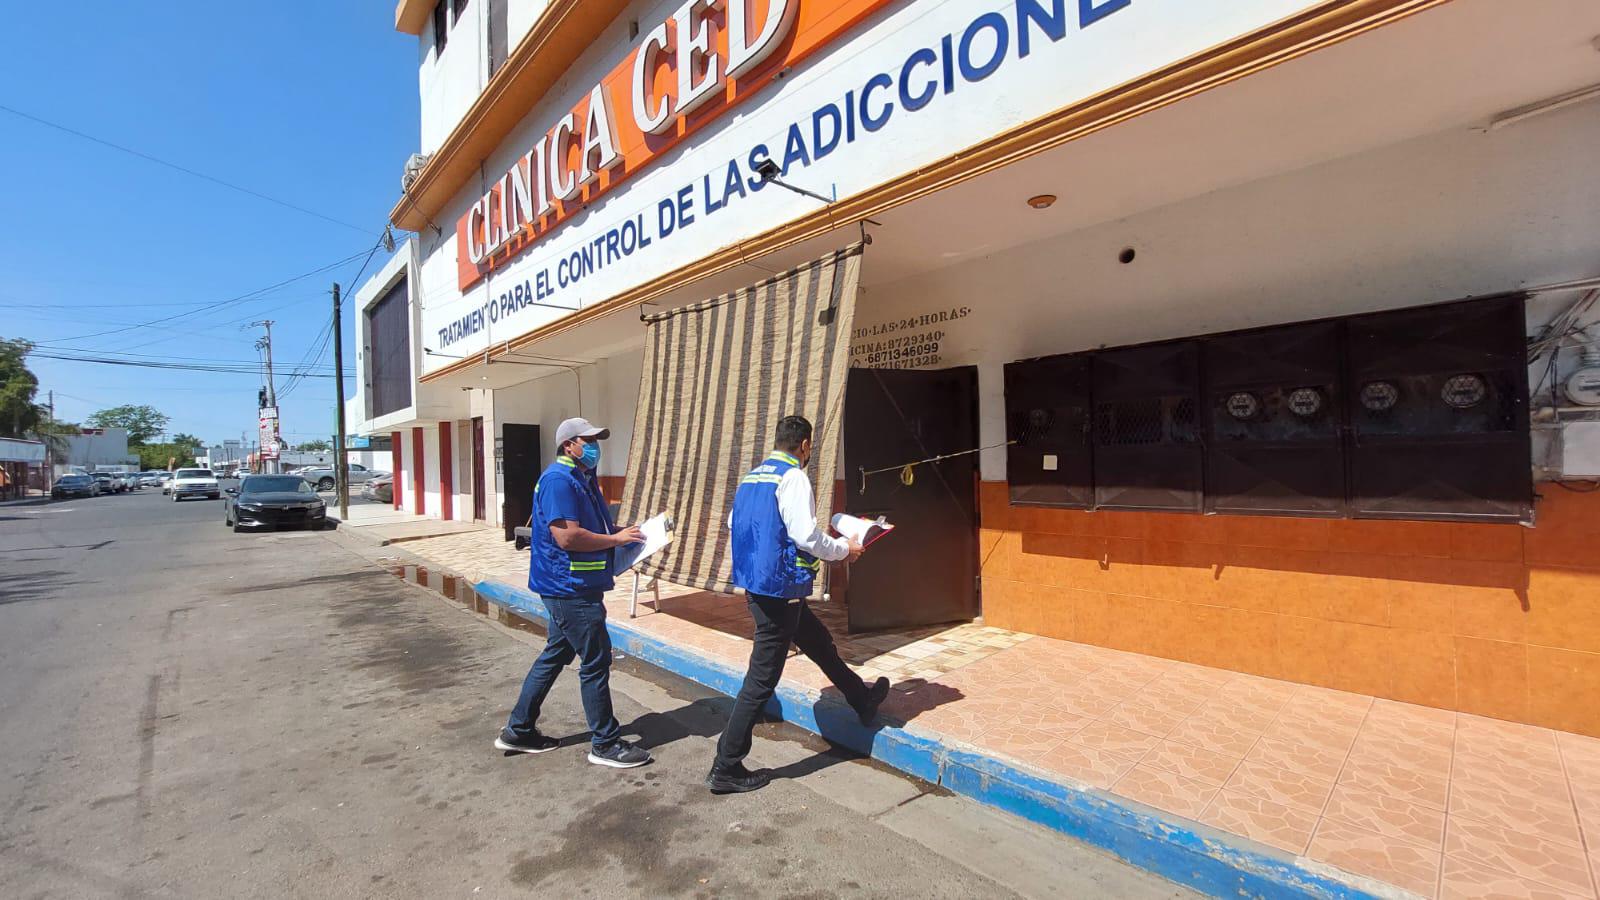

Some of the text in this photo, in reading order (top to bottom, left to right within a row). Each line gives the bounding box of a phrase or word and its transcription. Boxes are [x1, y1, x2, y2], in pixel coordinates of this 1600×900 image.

[438, 299, 498, 349] TRATAMIENO
[500, 280, 533, 319] PARA
[536, 268, 554, 300] EL
[557, 224, 651, 289] CONTROL
[658, 184, 695, 239] DE
[704, 144, 770, 215] LAS
[466, 82, 622, 265] CLINICA
